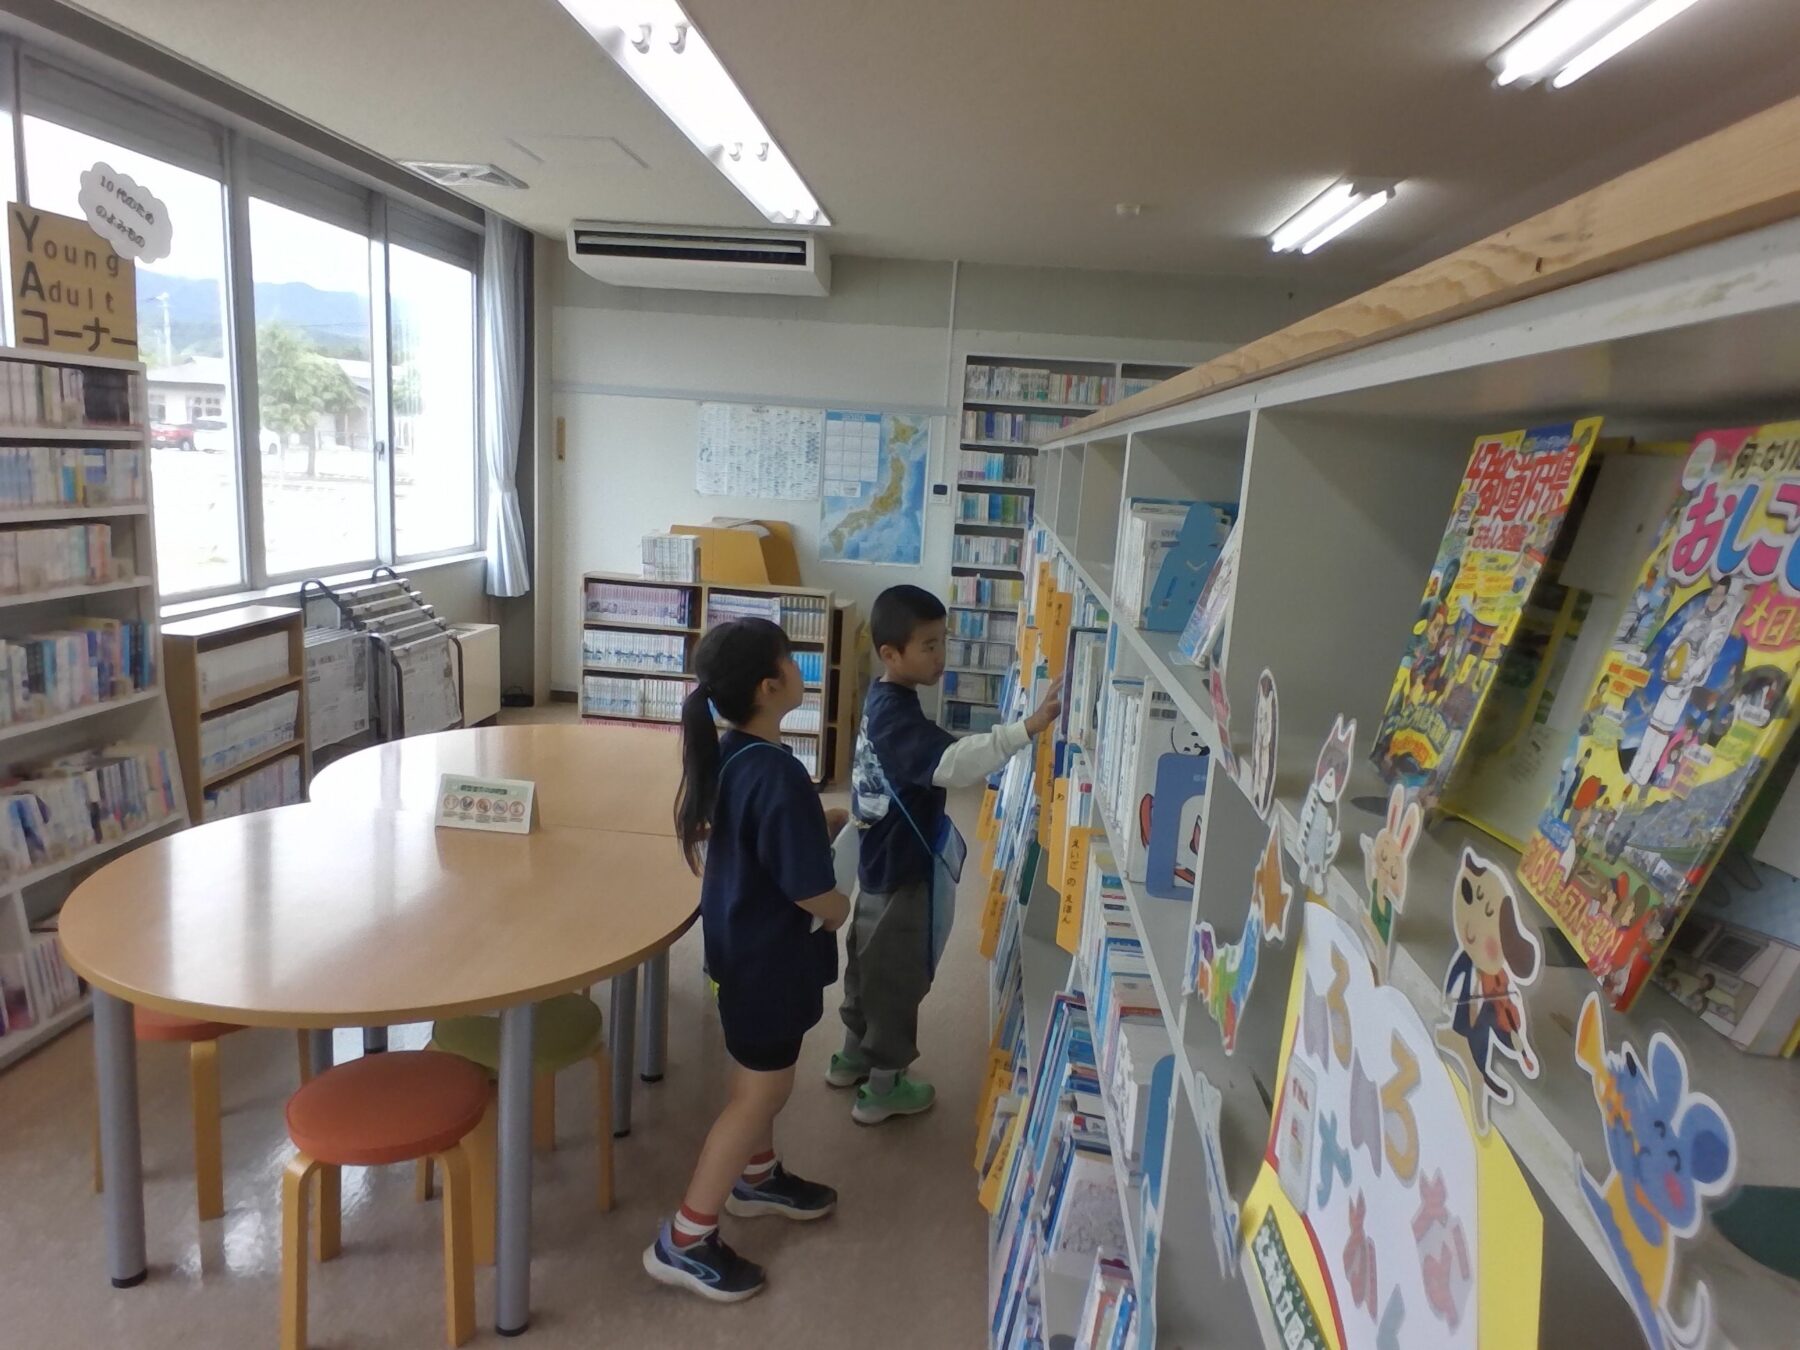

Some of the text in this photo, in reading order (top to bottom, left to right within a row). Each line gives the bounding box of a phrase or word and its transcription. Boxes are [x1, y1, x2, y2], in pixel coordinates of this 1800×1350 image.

[15, 210, 119, 277] Young
[19, 260, 115, 314] Adult
[21, 308, 138, 352] コーナー
